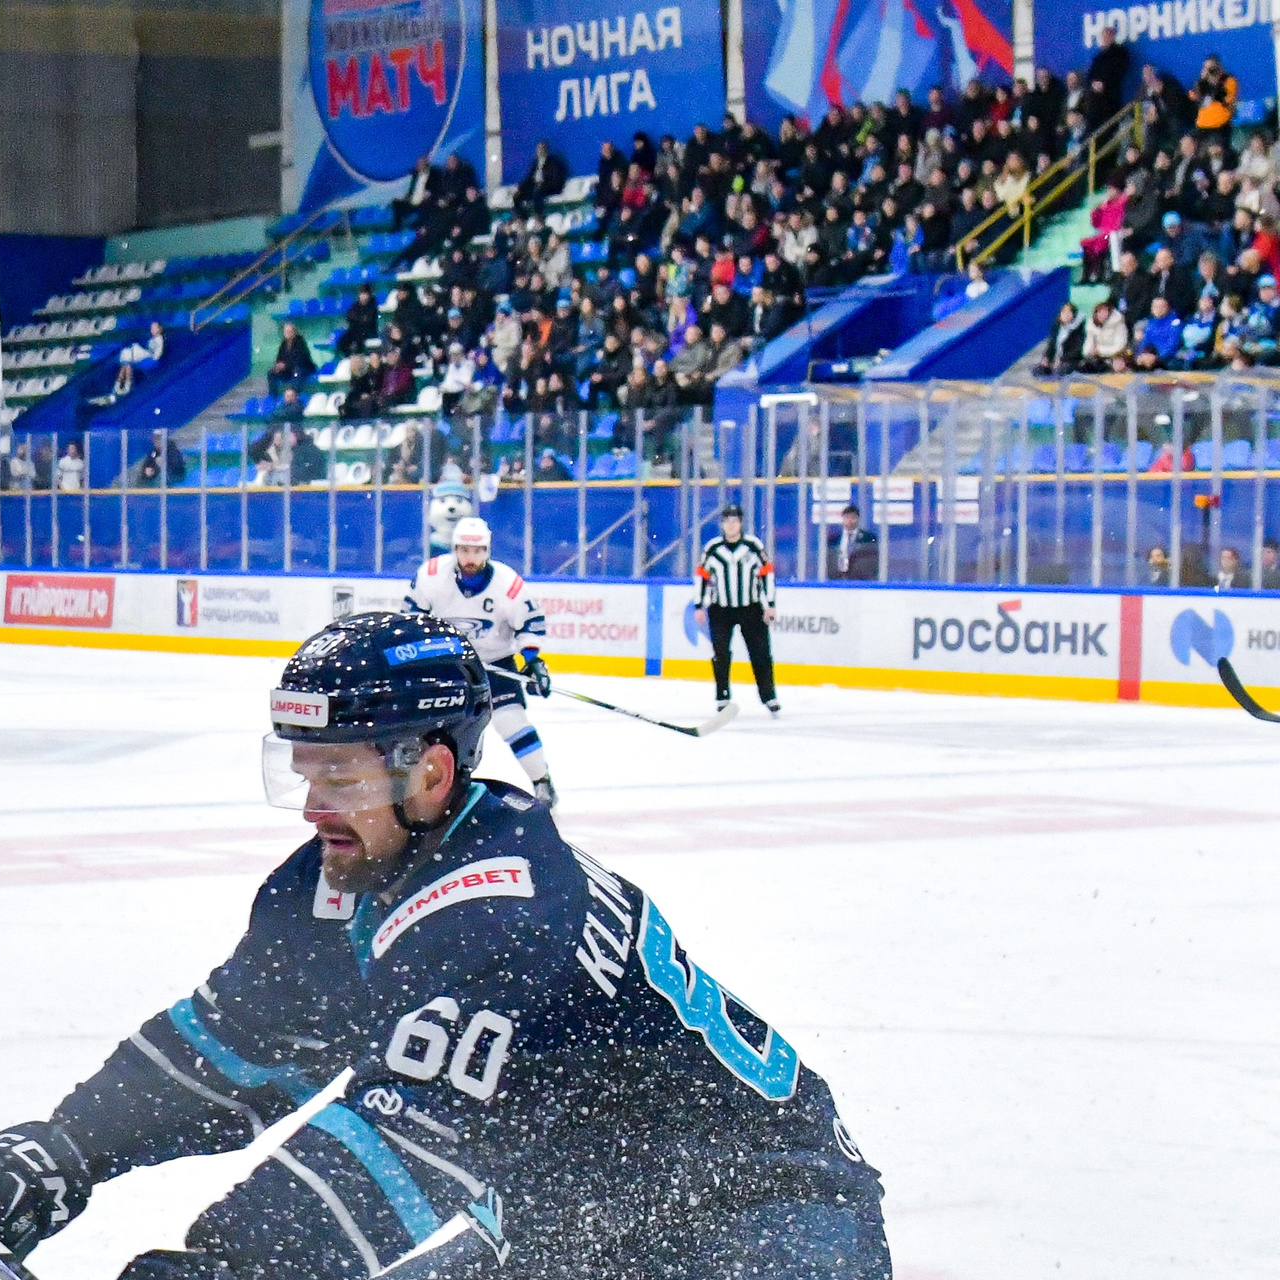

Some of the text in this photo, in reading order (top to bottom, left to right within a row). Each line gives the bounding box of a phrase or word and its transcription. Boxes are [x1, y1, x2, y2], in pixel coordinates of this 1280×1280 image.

[526, 6, 683, 70] НОЧНАЯ
[326, 39, 447, 119] МАТЧ
[554, 69, 657, 122] ЛИГА
[912, 599, 1109, 659] росбанк
[1248, 628, 1280, 651] НО
[417, 694, 466, 710] CCM
[377, 868, 522, 945] OLIMPBET
[385, 996, 513, 1100] 60
